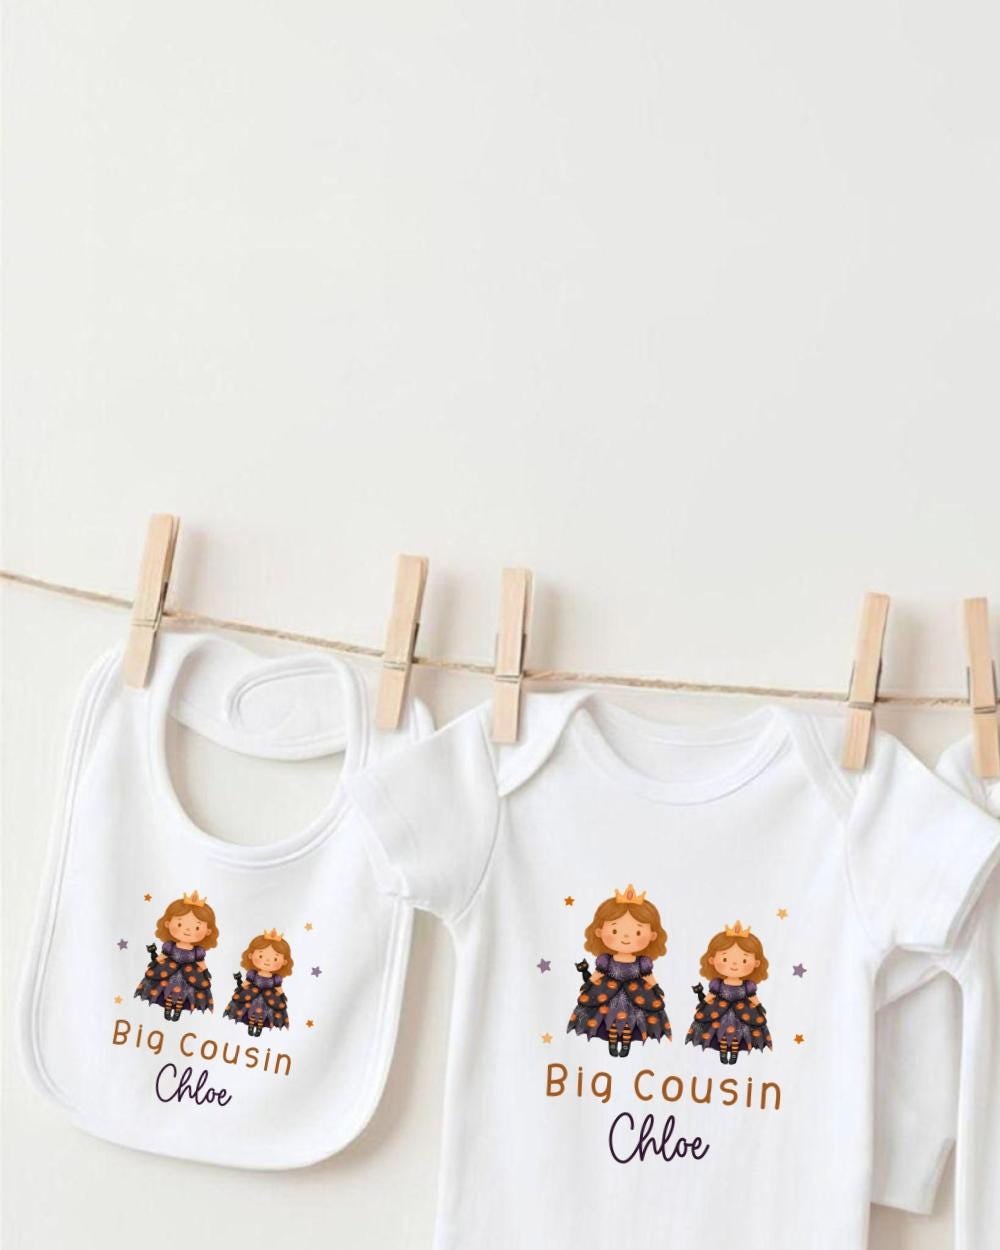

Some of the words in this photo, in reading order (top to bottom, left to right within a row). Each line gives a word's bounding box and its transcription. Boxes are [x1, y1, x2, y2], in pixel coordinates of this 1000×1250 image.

[111, 1019, 165, 1055] Big
[179, 1031, 292, 1076] Cousin
[155, 1062, 233, 1107] Chloe
[545, 1062, 613, 1104] Big
[633, 1068, 782, 1111] Cousin
[608, 1111, 710, 1165] Chloe
